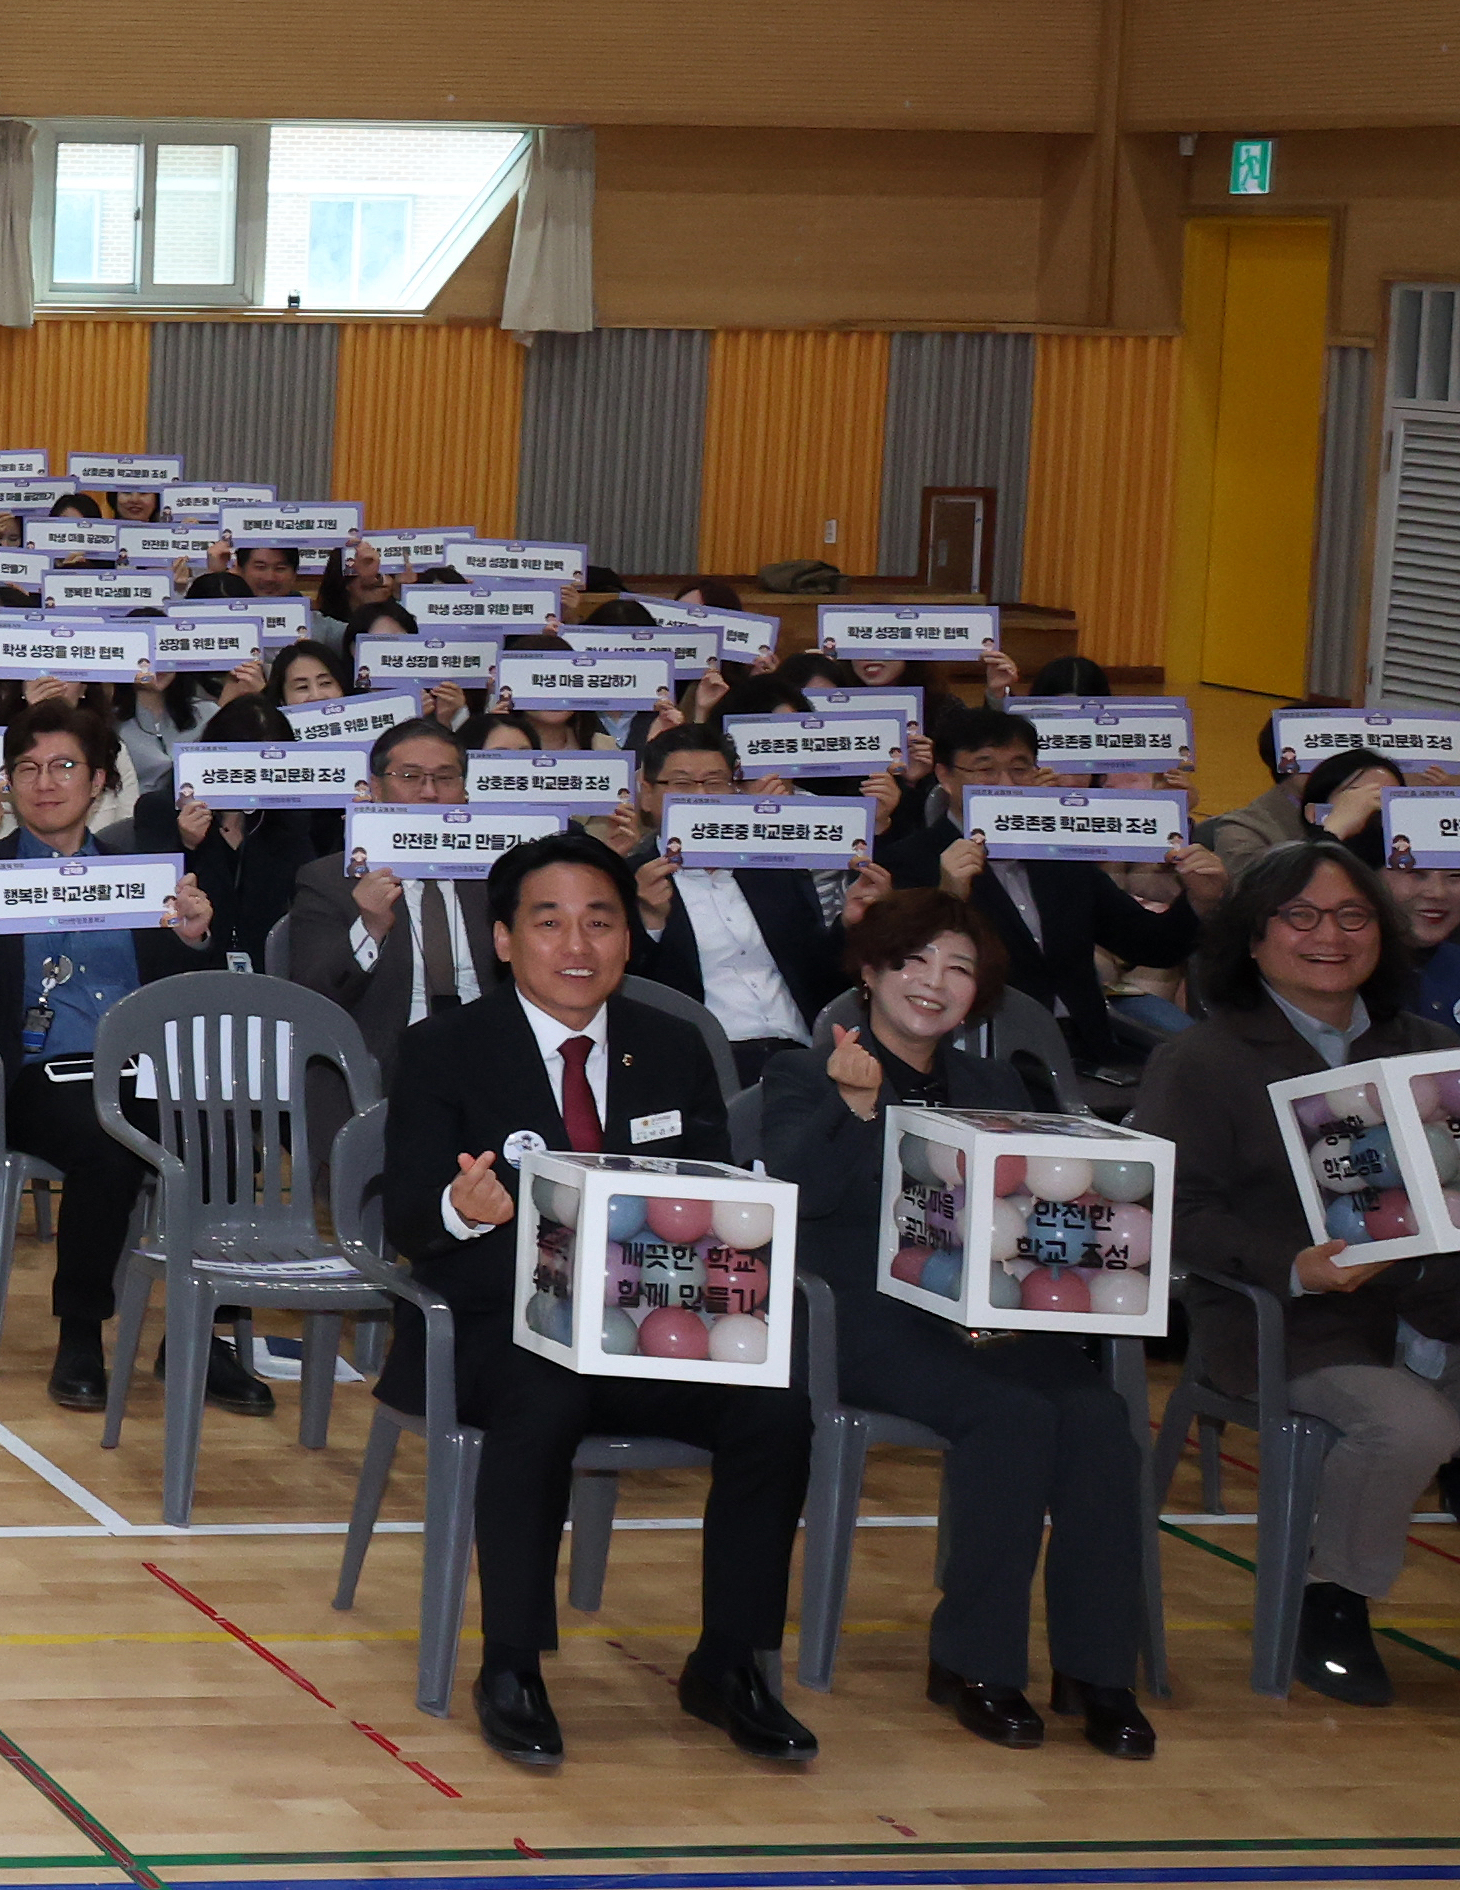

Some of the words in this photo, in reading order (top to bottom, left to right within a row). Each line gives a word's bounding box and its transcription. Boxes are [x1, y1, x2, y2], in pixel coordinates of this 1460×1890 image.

[848, 626, 872, 640] 학생
[875, 626, 911, 640] 성장을
[916, 626, 941, 640] 위한
[944, 627, 968, 640] 협력
[3, 643, 27, 658] 학생
[31, 644, 66, 659] 성장을
[71, 645, 95, 660] 위한
[100, 646, 123, 660] 협력
[533, 673, 556, 688] 학생
[560, 674, 583, 688] 마음
[588, 674, 636, 688] 공감하기
[748, 738, 798, 755] 상호존중
[802, 736, 851, 752] 학교문화
[855, 735, 880, 751] 조성
[1305, 733, 1365, 753] 상호존중
[1365, 733, 1423, 753] 학교문화
[1427, 735, 1452, 751] 조성
[203, 768, 256, 784] 상호존중
[261, 767, 314, 784] 학교문화
[319, 767, 345, 783] 조성
[692, 822, 748, 841] 상호존중
[753, 823, 810, 841] 학교문화
[814, 824, 842, 842] 조성
[995, 814, 1055, 833] 상호존중
[1061, 815, 1122, 833] 학교문화
[1127, 817, 1156, 835] 조성
[5, 887, 48, 906] 행복한
[53, 884, 111, 903] 학교생활
[116, 882, 144, 900] 지원
[1034, 1202, 1115, 1230] 안전한
[621, 1242, 697, 1273] 깨끗한
[707, 1242, 758, 1273] 학교
[1016, 1237, 1069, 1270] 학교
[1080, 1237, 1130, 1270] 조성
[616, 1279, 670, 1312] 함께
[679, 1279, 756, 1312] 만들기
